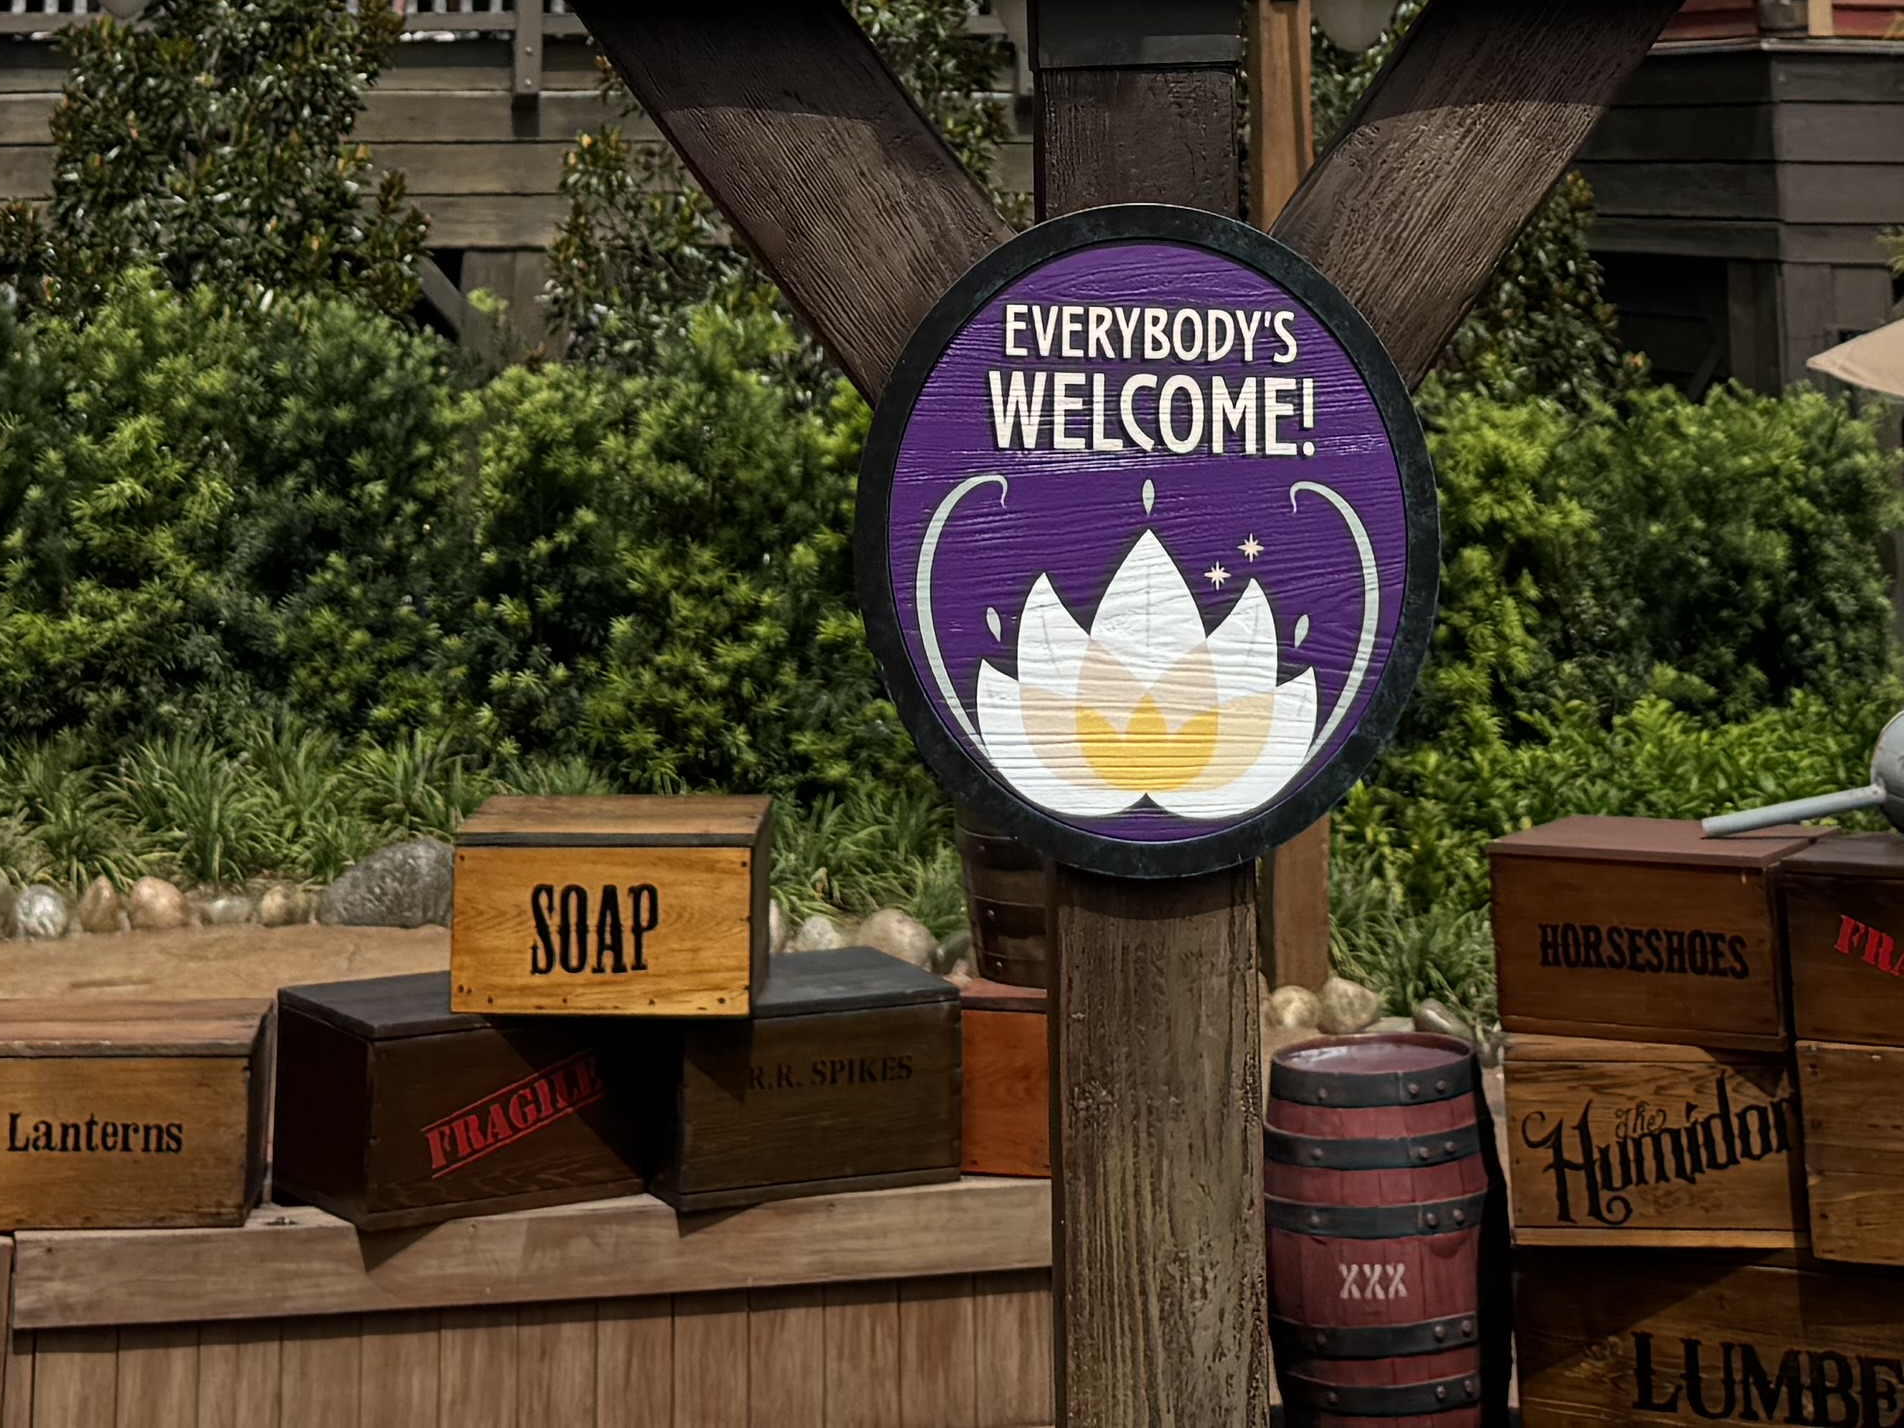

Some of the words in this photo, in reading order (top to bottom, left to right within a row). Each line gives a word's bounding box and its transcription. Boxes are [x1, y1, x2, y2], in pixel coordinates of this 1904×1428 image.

[1003, 303, 1299, 365] EVERYBODY'S
[987, 370, 1317, 457] WELCOME!
[529, 883, 660, 976] SOAP
[1538, 922, 1751, 981] HORSESHOES
[748, 1063, 802, 1092] R.R.
[810, 1054, 915, 1087] SPIKES
[6, 1111, 184, 1154] Lanterns
[425, 1053, 605, 1170] FRAGILE
[1614, 1100, 1668, 1140] The
[1522, 1067, 1795, 1226] Humidor
[1338, 1262, 1409, 1301] XXX
